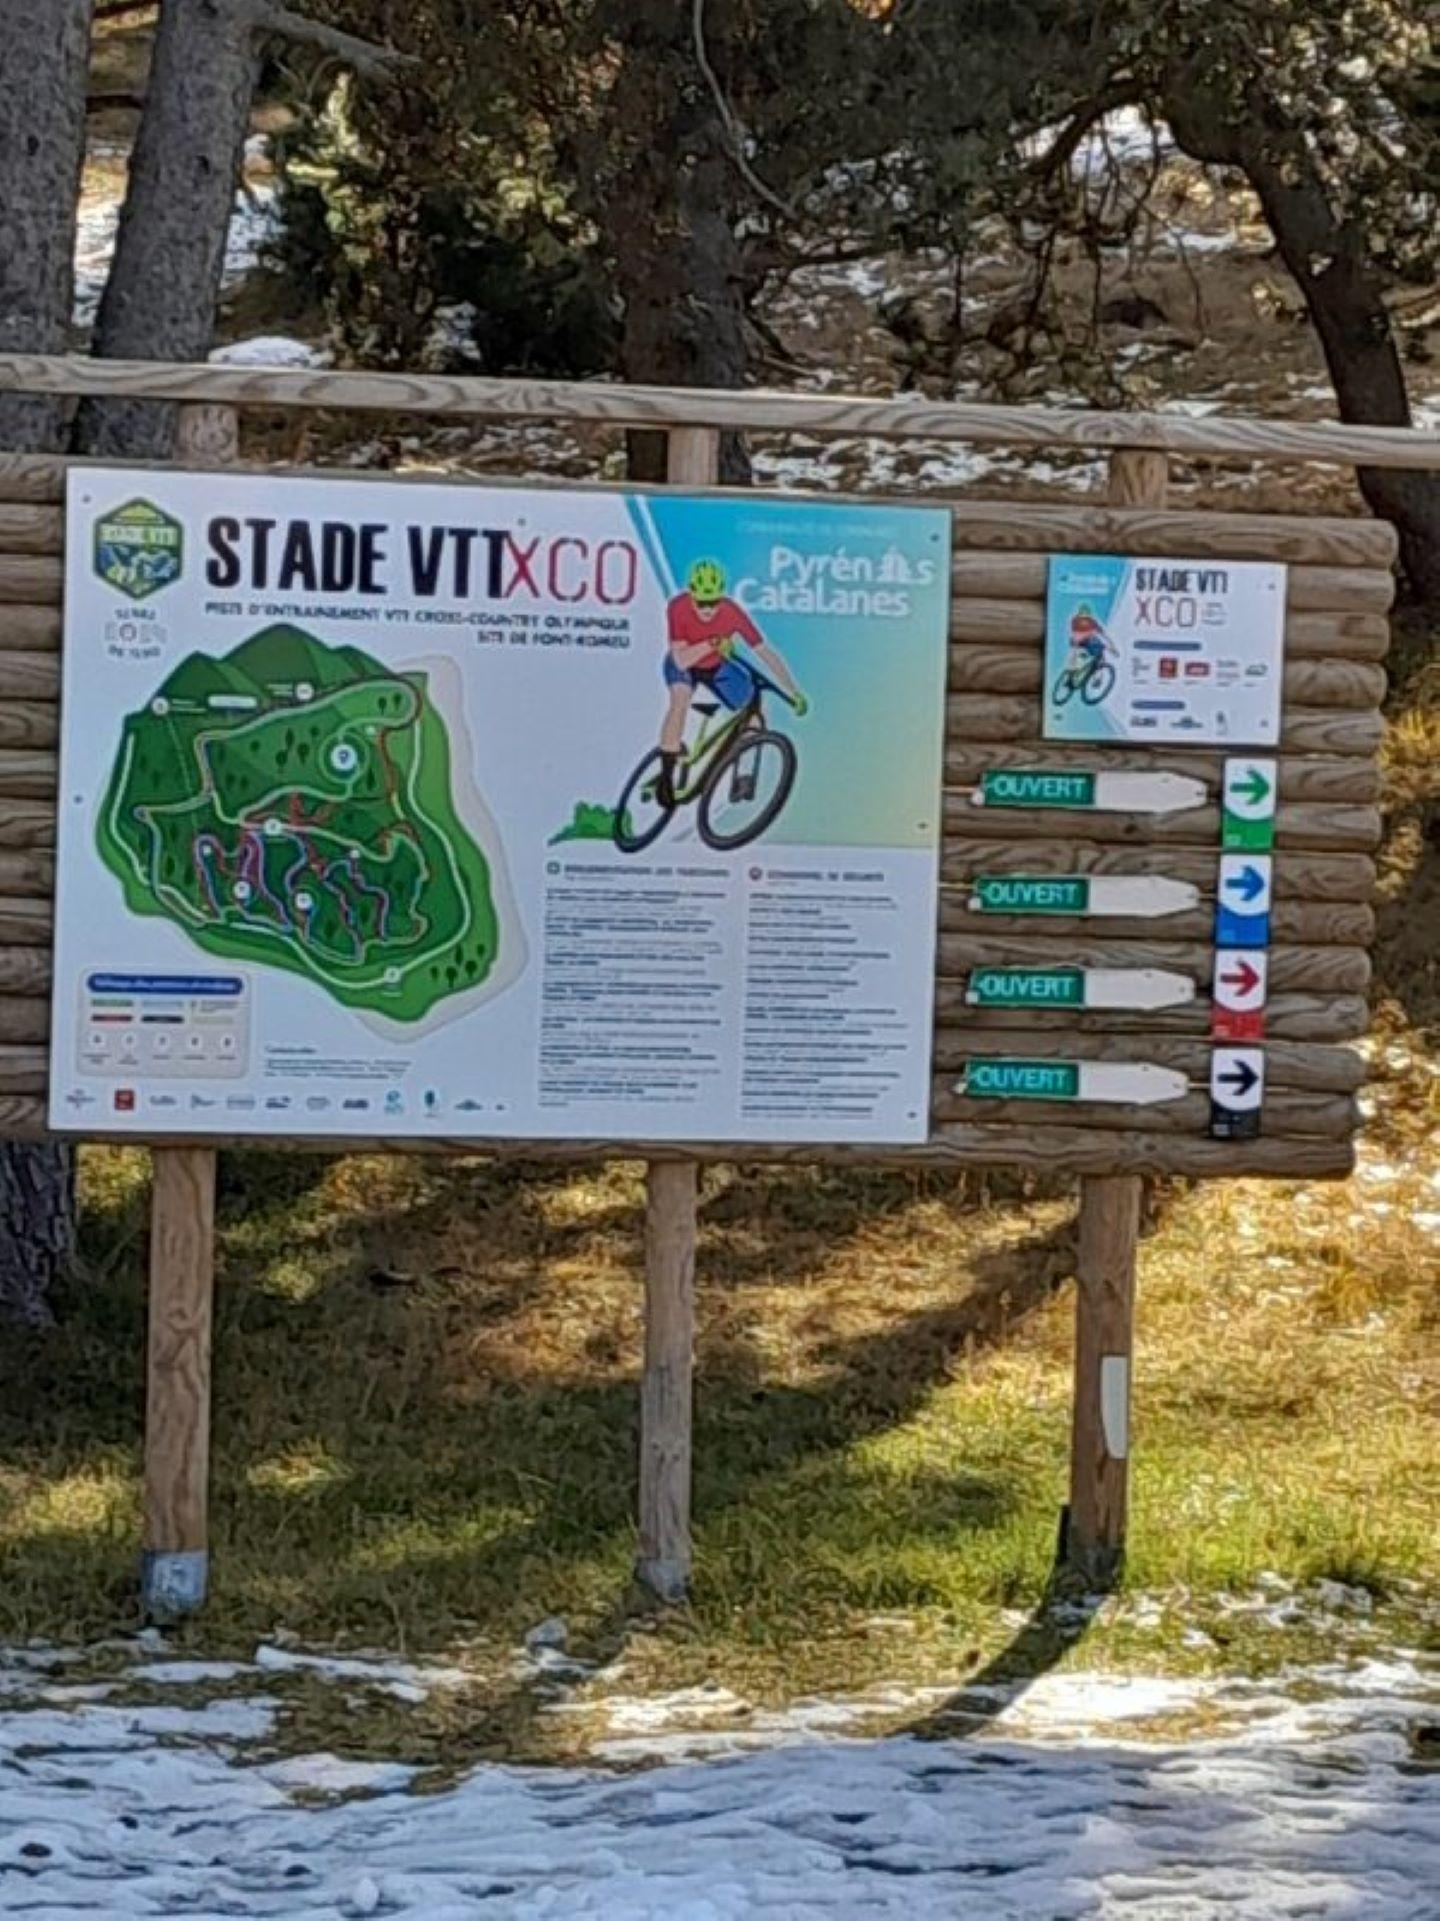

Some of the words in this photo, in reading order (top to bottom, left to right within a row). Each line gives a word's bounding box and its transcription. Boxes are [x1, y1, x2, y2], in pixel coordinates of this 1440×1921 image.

[206, 516, 388, 594] STADE
[407, 525, 508, 599] VTT
[503, 536, 637, 605] XCO
[1135, 568, 1189, 592] STADE
[1198, 570, 1228, 594] VTT
[1134, 596, 1197, 627] XCO
[993, 775, 1085, 797] OUVERT
[987, 882, 1078, 904] OUVERT
[981, 975, 1076, 997] OUVERT
[976, 1066, 1067, 1089] OUVERT
